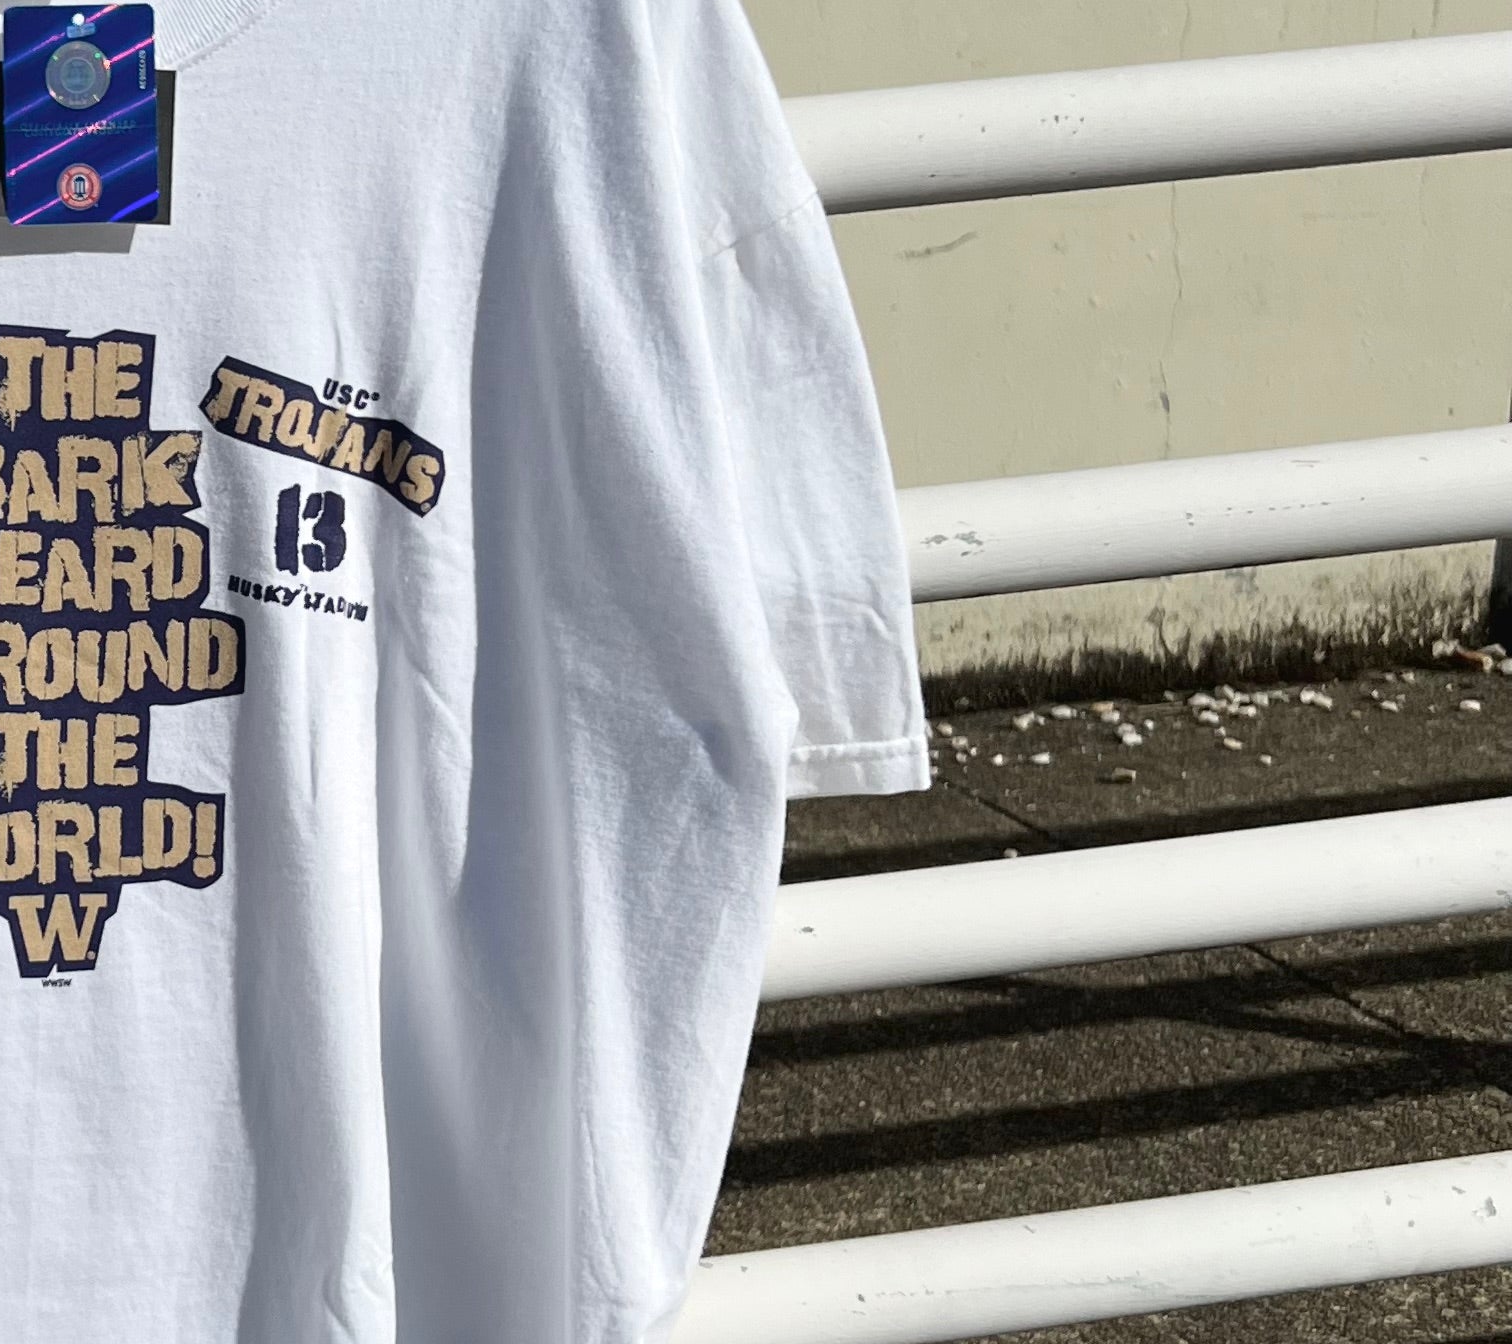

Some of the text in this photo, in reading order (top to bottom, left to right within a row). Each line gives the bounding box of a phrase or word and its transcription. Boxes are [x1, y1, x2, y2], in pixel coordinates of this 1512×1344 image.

[201, 367, 441, 505] TROJANS
[274, 483, 347, 576] 13
[228, 574, 302, 607] HUSKY
[7, 892, 108, 963] W
